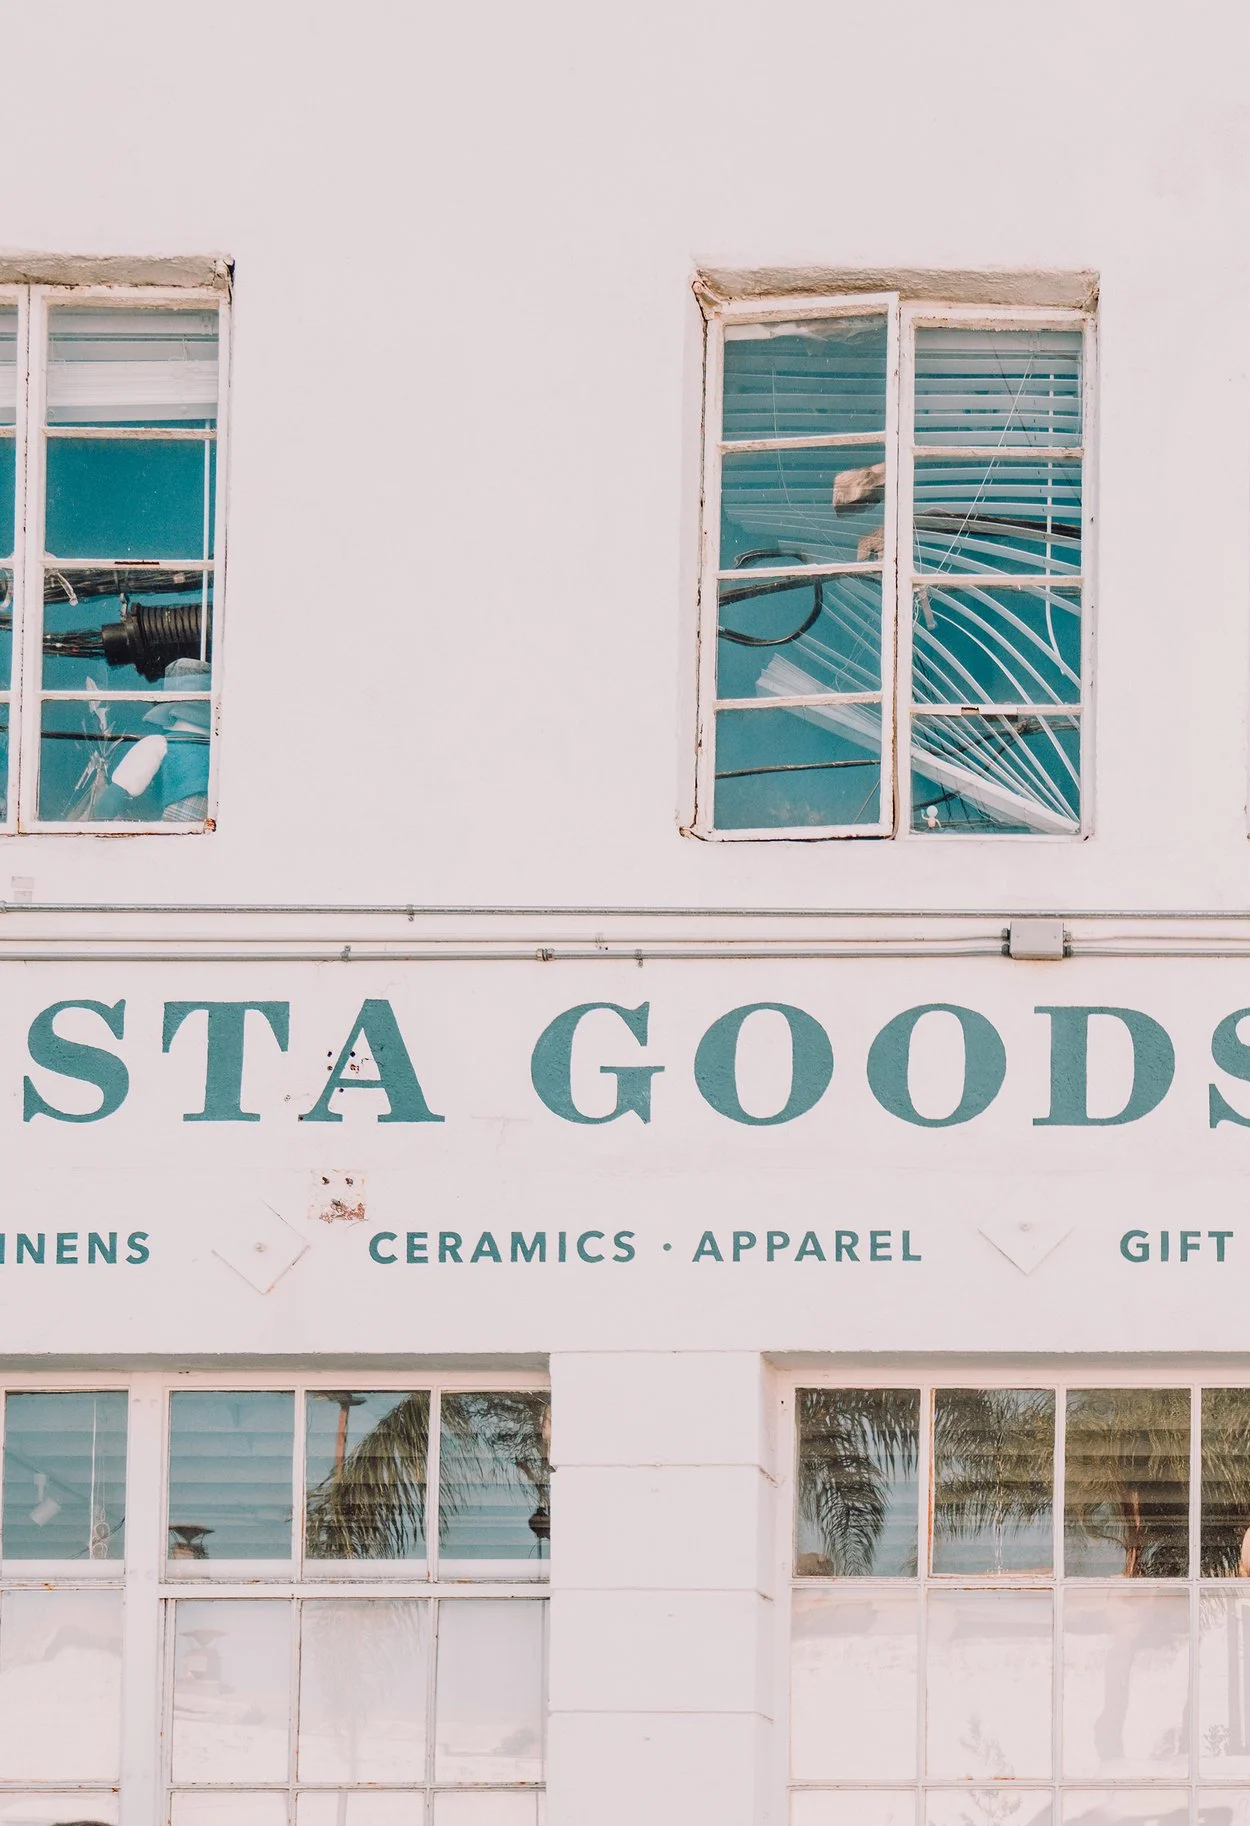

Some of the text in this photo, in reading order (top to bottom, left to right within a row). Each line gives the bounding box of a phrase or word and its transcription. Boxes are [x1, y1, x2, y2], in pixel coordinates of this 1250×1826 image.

[23, 998, 445, 1123] STA
[369, 1231, 922, 1264] CERAMICS APPAREL
[1120, 1230, 1233, 1263] GIFT
